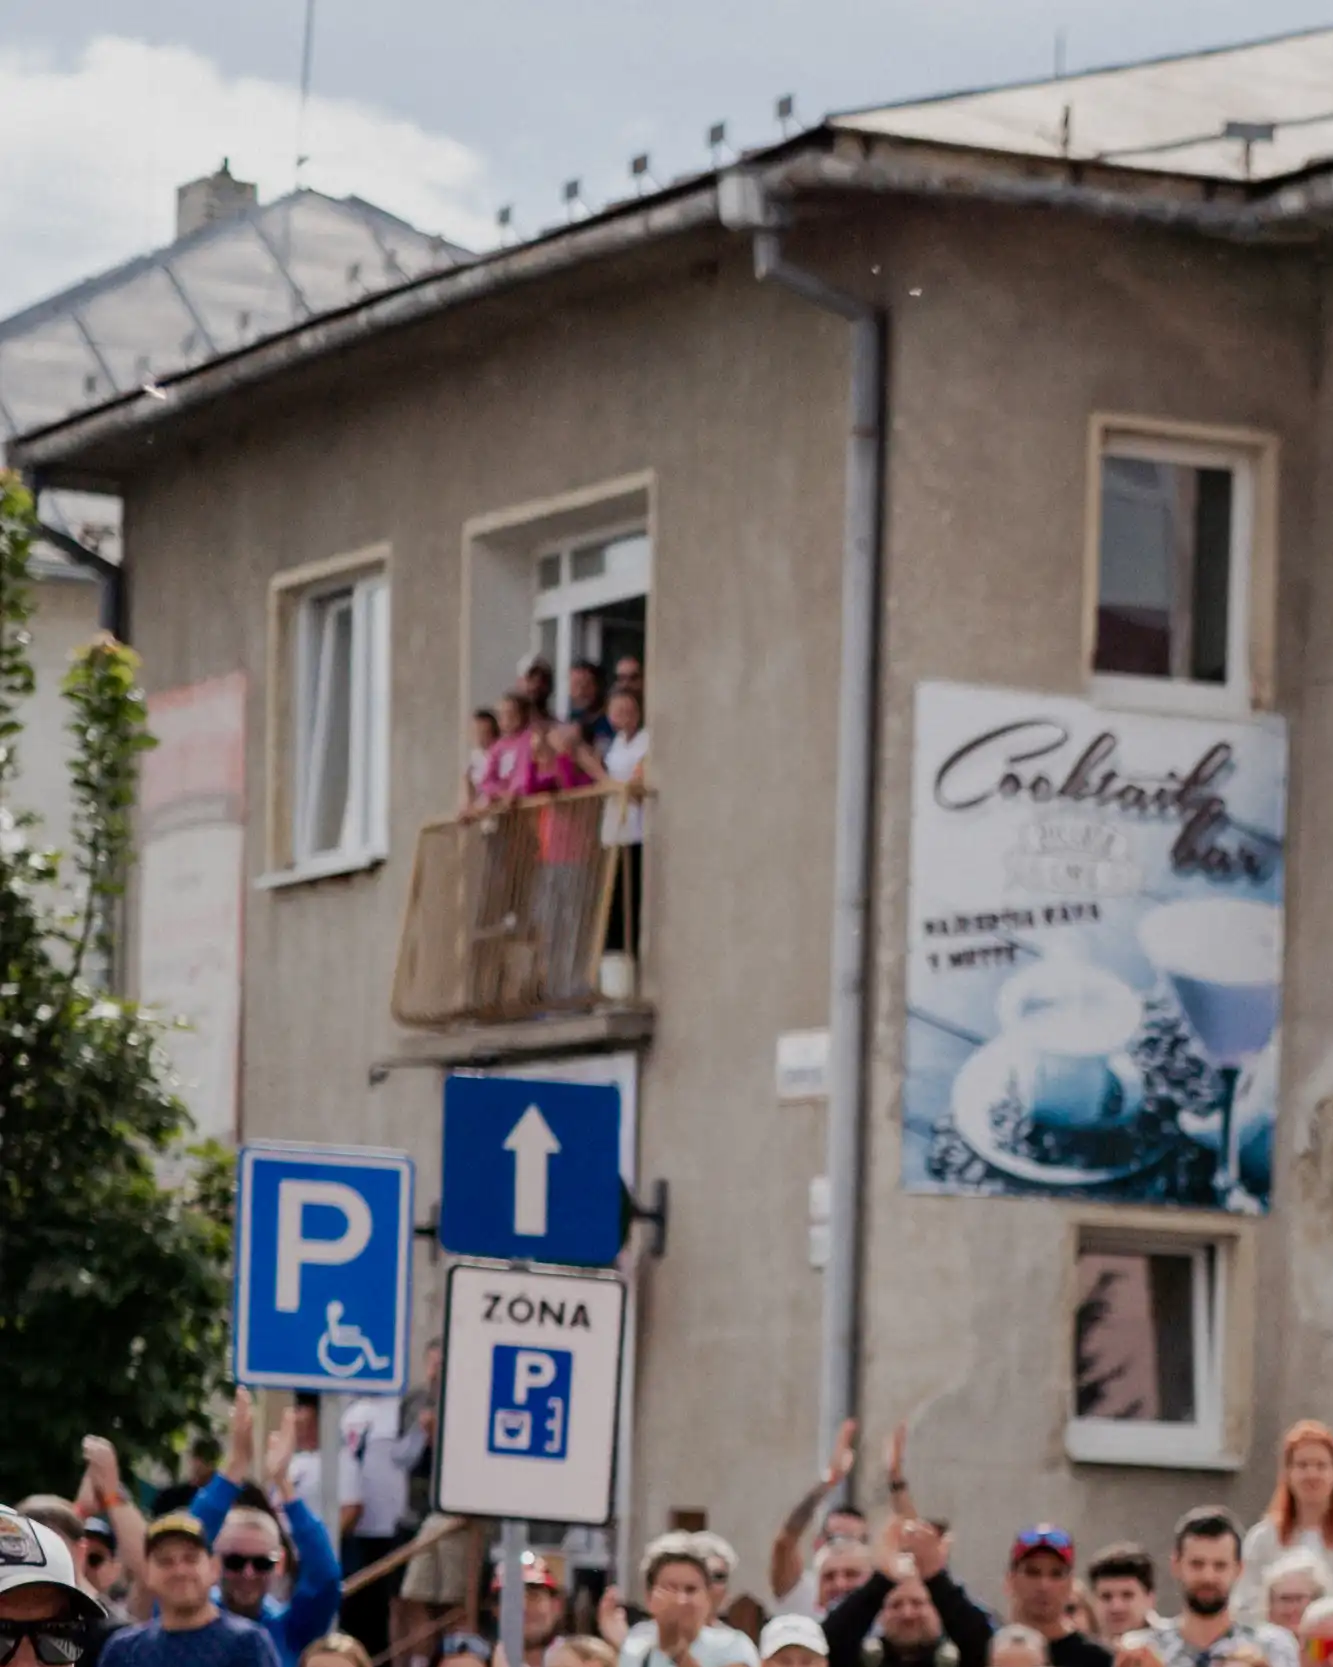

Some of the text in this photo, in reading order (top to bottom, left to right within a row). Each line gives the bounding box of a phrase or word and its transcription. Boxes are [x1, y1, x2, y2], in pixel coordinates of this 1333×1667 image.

[275, 1178, 373, 1314] P
[481, 1291, 592, 1330] ZÓNA
[513, 1350, 557, 1406] P
